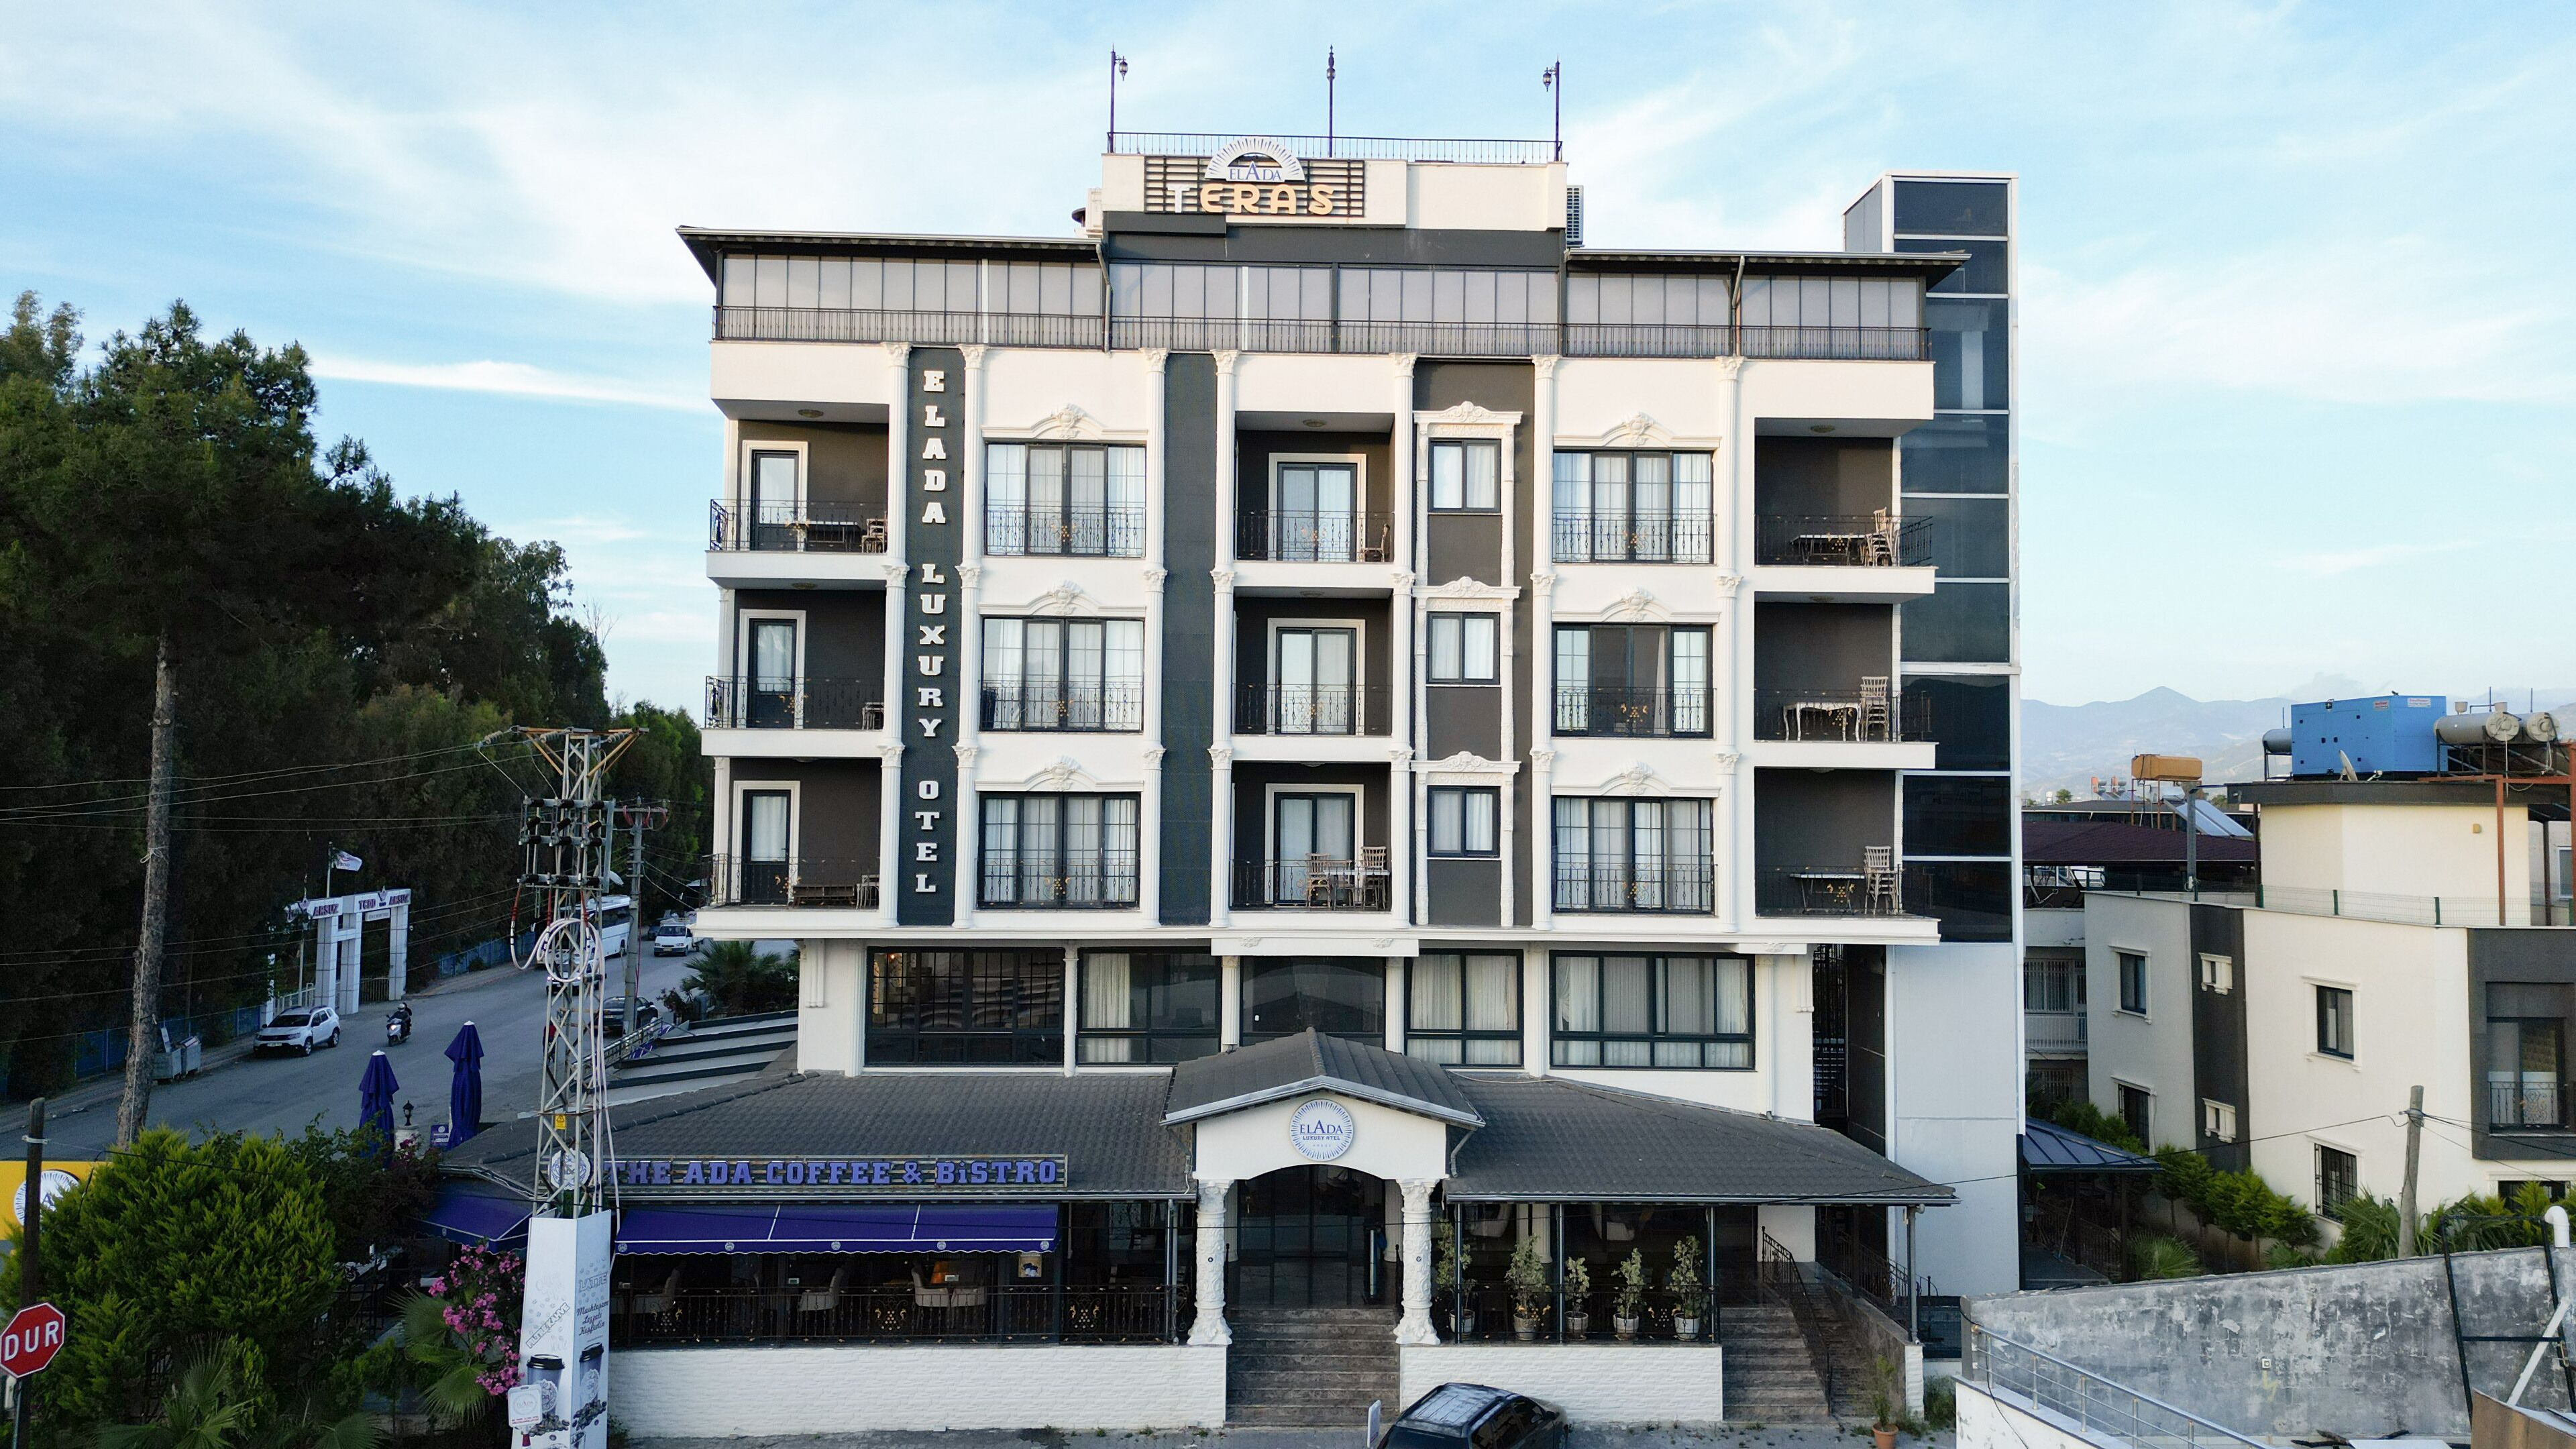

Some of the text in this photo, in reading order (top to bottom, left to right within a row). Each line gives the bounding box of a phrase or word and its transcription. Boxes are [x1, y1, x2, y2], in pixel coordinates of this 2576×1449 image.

[1230, 161, 1282, 180] ELADA
[1168, 183, 1334, 215] TERAS
[914, 370, 946, 893] ELADA LUXURY OTEL
[313, 904, 339, 916] ARSUZ
[1299, 1120, 1343, 1134] ELADA
[604, 1161, 671, 1184] THE
[683, 1161, 753, 1184] ADA
[766, 1161, 891, 1184] COFFEE
[902, 1161, 923, 1184] &
[579, 1272, 608, 1293] LATTE
[4, 1320, 60, 1361] DUR
